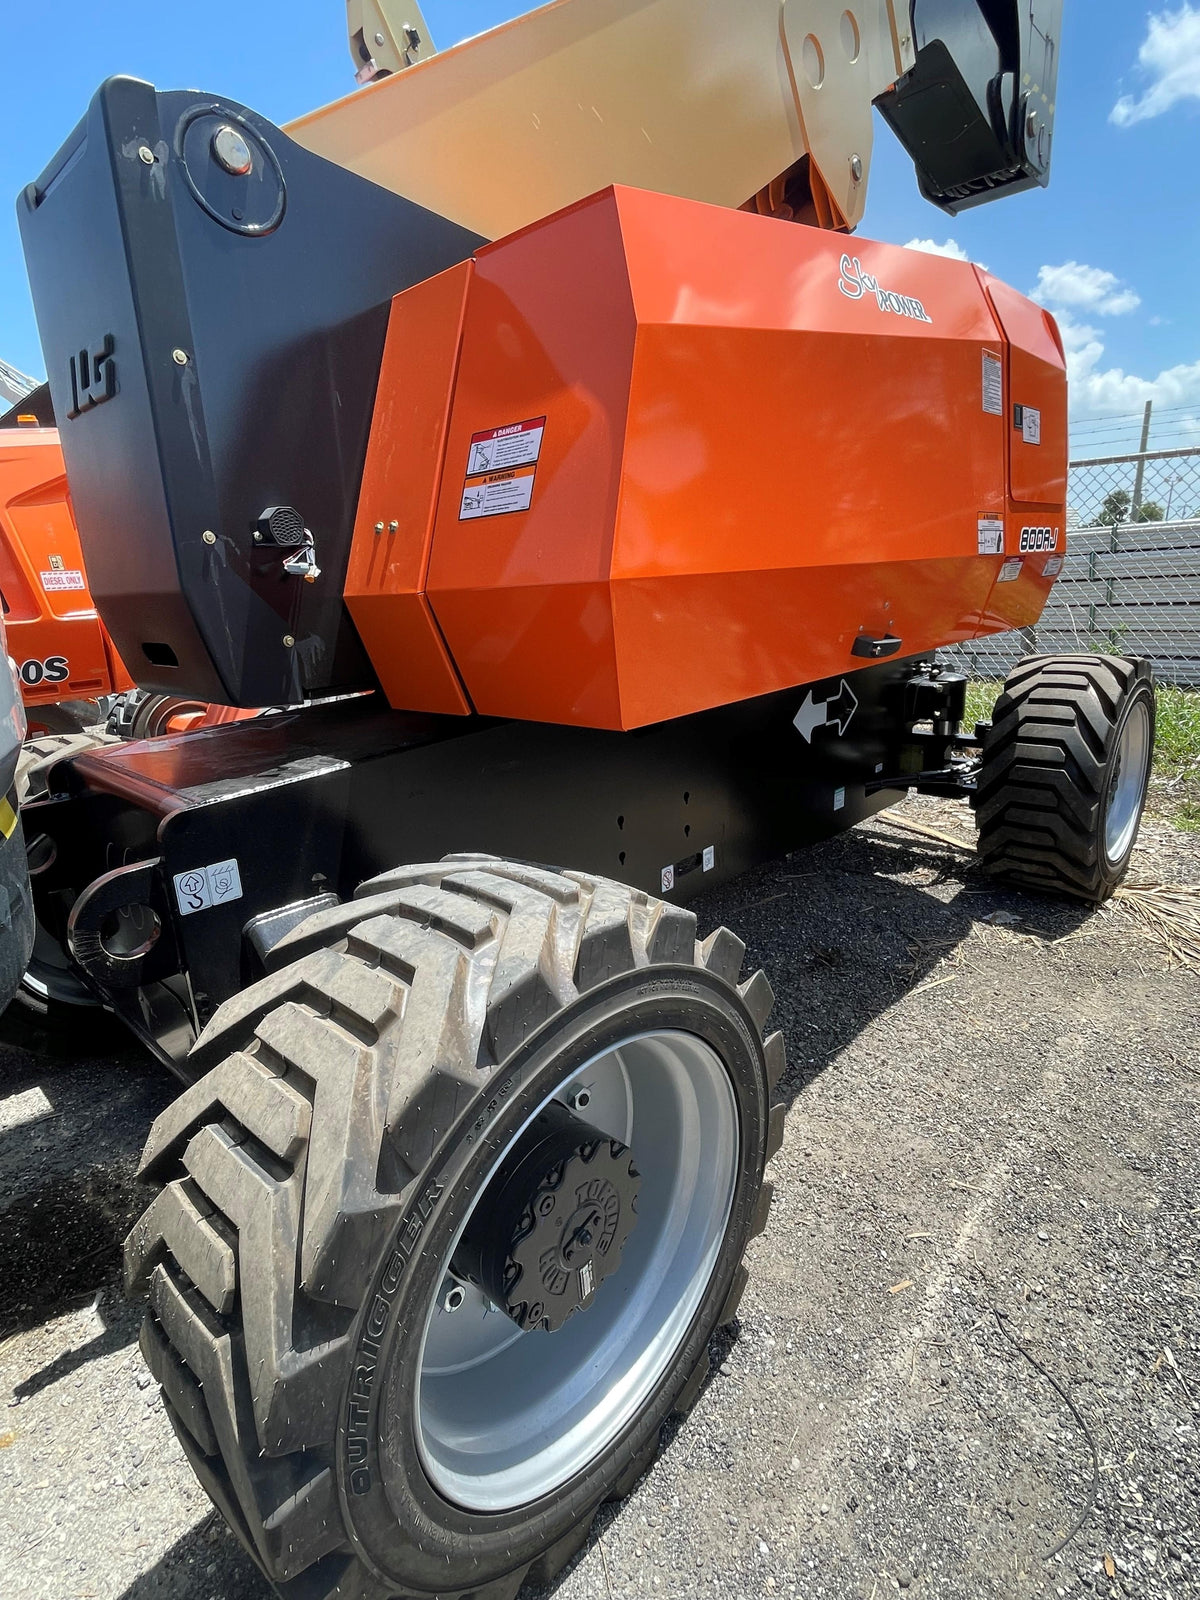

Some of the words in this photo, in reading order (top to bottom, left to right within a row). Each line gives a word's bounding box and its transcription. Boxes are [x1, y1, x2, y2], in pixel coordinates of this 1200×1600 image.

[878, 288, 933, 323] POWER
[497, 425, 522, 437] DANGER
[488, 472, 515, 482] WARNING
[43, 576, 65, 586] DIESEL
[66, 576, 82, 585] ONLY
[16, 656, 69, 685] 0S
[348, 1175, 445, 1497] OUTRIGGER
